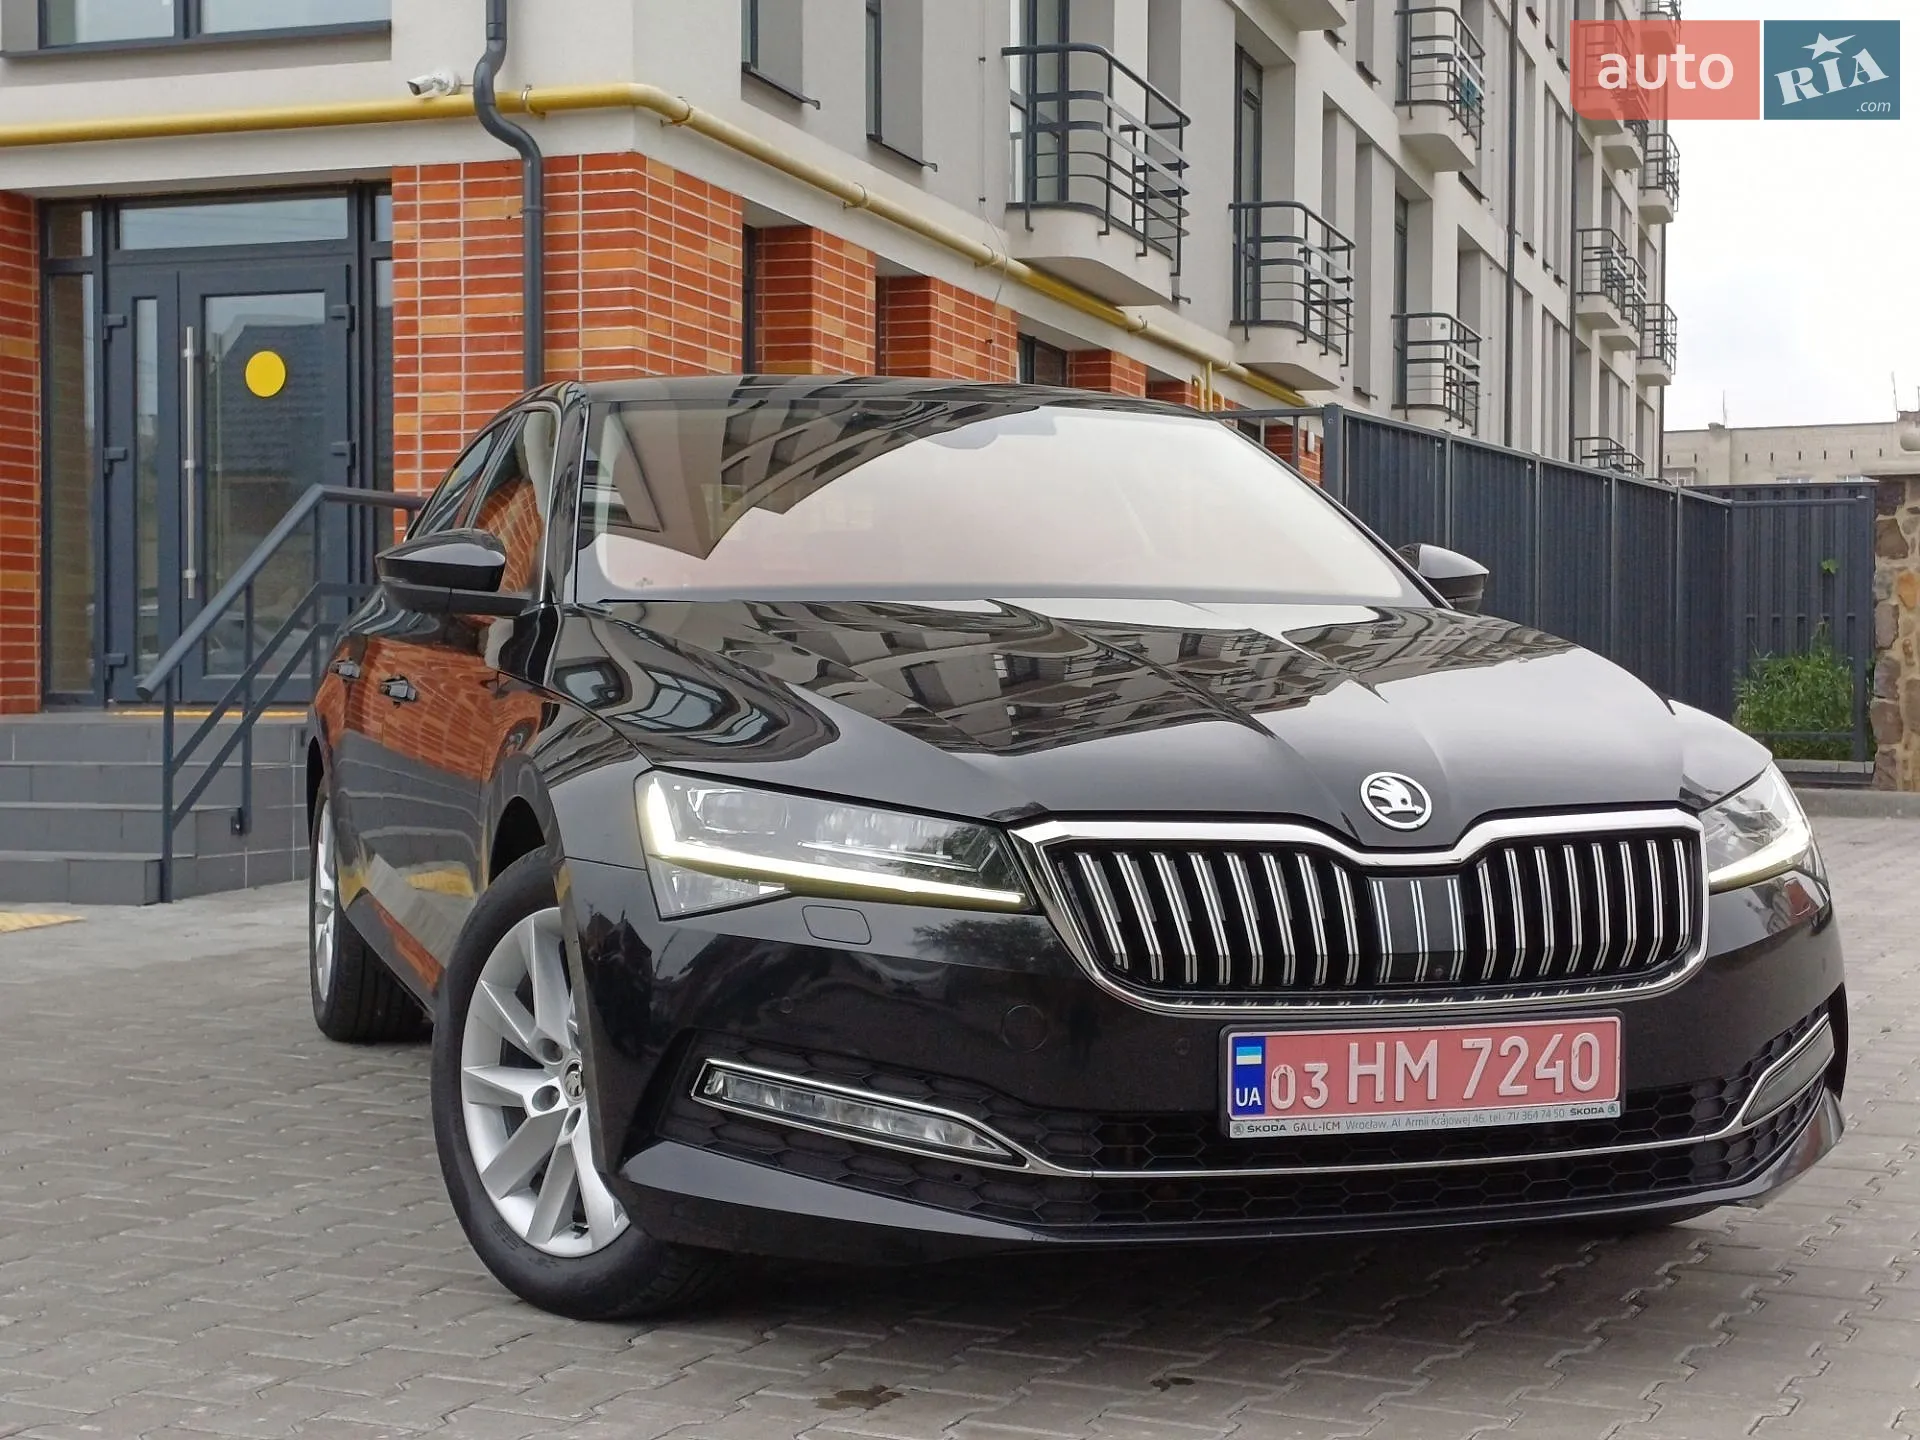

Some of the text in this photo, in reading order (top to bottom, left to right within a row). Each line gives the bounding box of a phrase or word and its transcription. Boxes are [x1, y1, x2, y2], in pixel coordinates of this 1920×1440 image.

[1270, 1032, 1600, 1110] 03 HM 7240
[1236, 1087, 1262, 1107] UA
